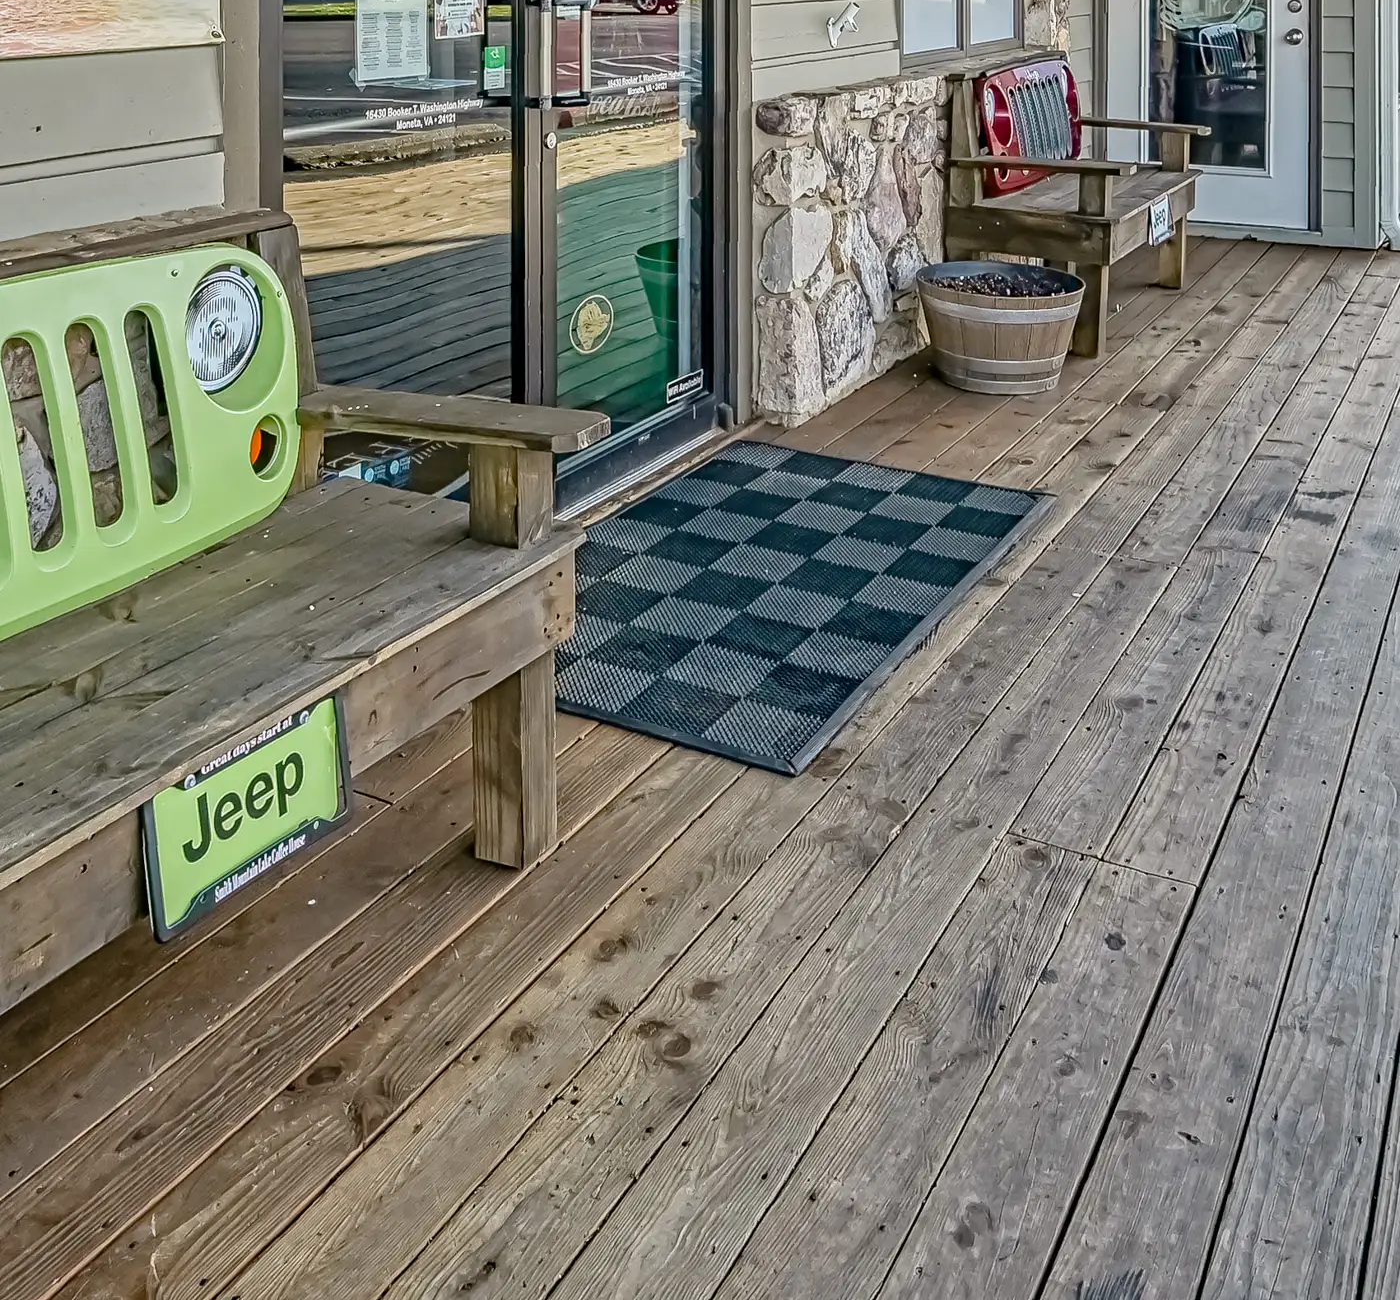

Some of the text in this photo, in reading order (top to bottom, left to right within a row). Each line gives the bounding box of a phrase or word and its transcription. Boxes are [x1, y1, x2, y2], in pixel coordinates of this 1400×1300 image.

[387, 106, 412, 117] Booker
[420, 101, 457, 113] Washington
[457, 98, 484, 110] Highway
[423, 115, 434, 126] VA
[437, 113, 456, 125] 24121
[201, 715, 293, 775] Great days start at
[182, 751, 304, 862] Jeep
[258, 853, 272, 873] Lake
[271, 842, 289, 864] Coffee
